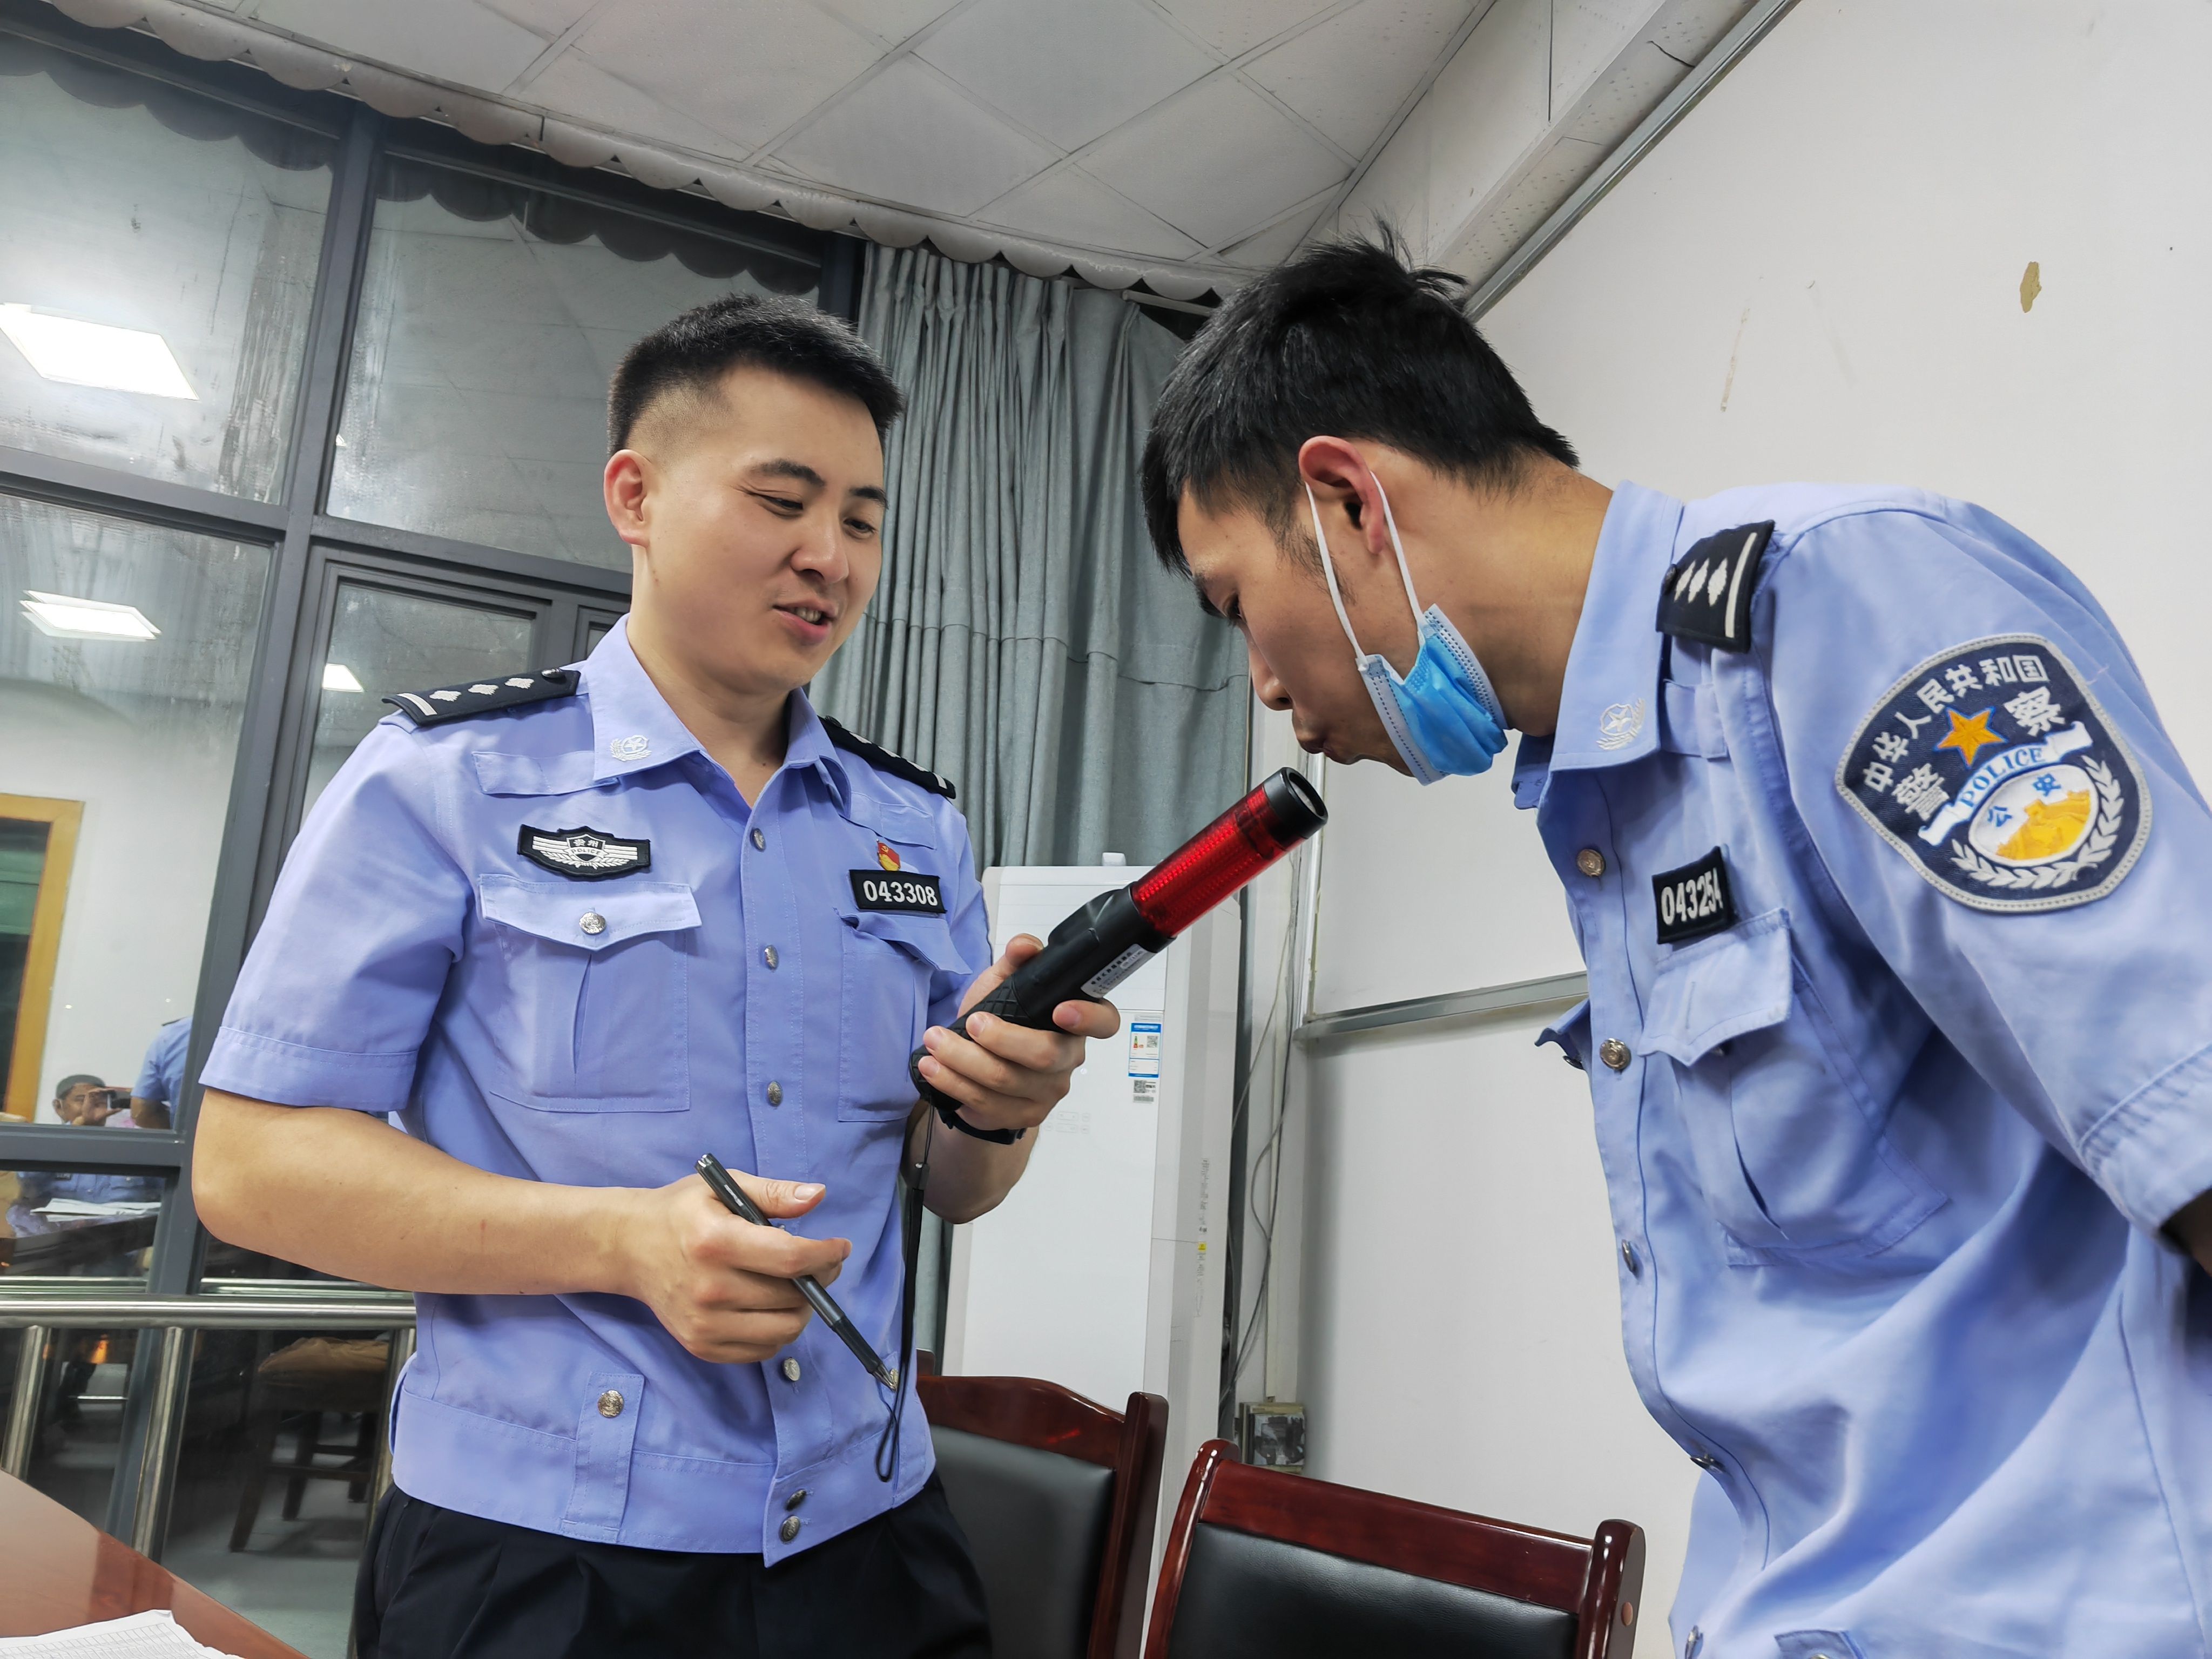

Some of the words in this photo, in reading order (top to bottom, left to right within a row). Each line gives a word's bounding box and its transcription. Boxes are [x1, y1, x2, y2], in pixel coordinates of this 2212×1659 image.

[1863, 655, 2050, 793] 中华人民共和国
[1960, 747, 2046, 808] POLICE
[863, 880, 938, 906] 043308
[1661, 867, 1724, 926] 043254
